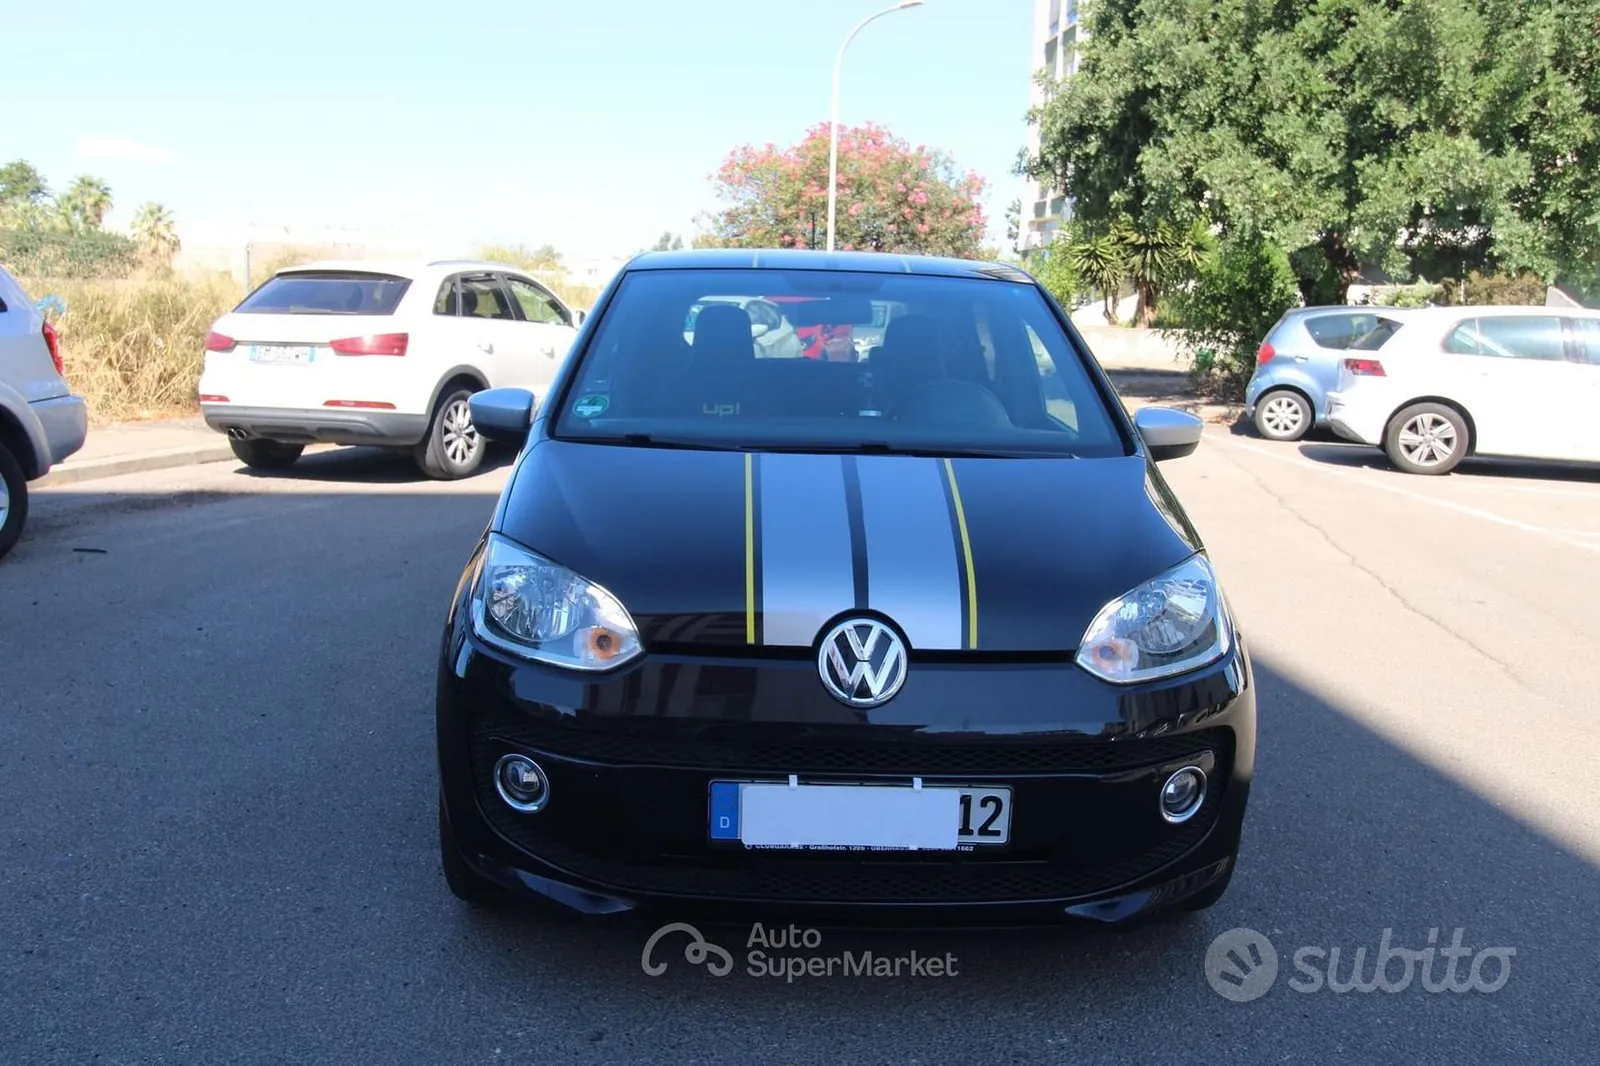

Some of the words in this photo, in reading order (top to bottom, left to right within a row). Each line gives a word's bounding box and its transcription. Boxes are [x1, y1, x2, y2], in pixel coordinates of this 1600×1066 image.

[702, 403, 740, 417] up!
[958, 794, 1003, 836] 12
[719, 816, 730, 829] D
